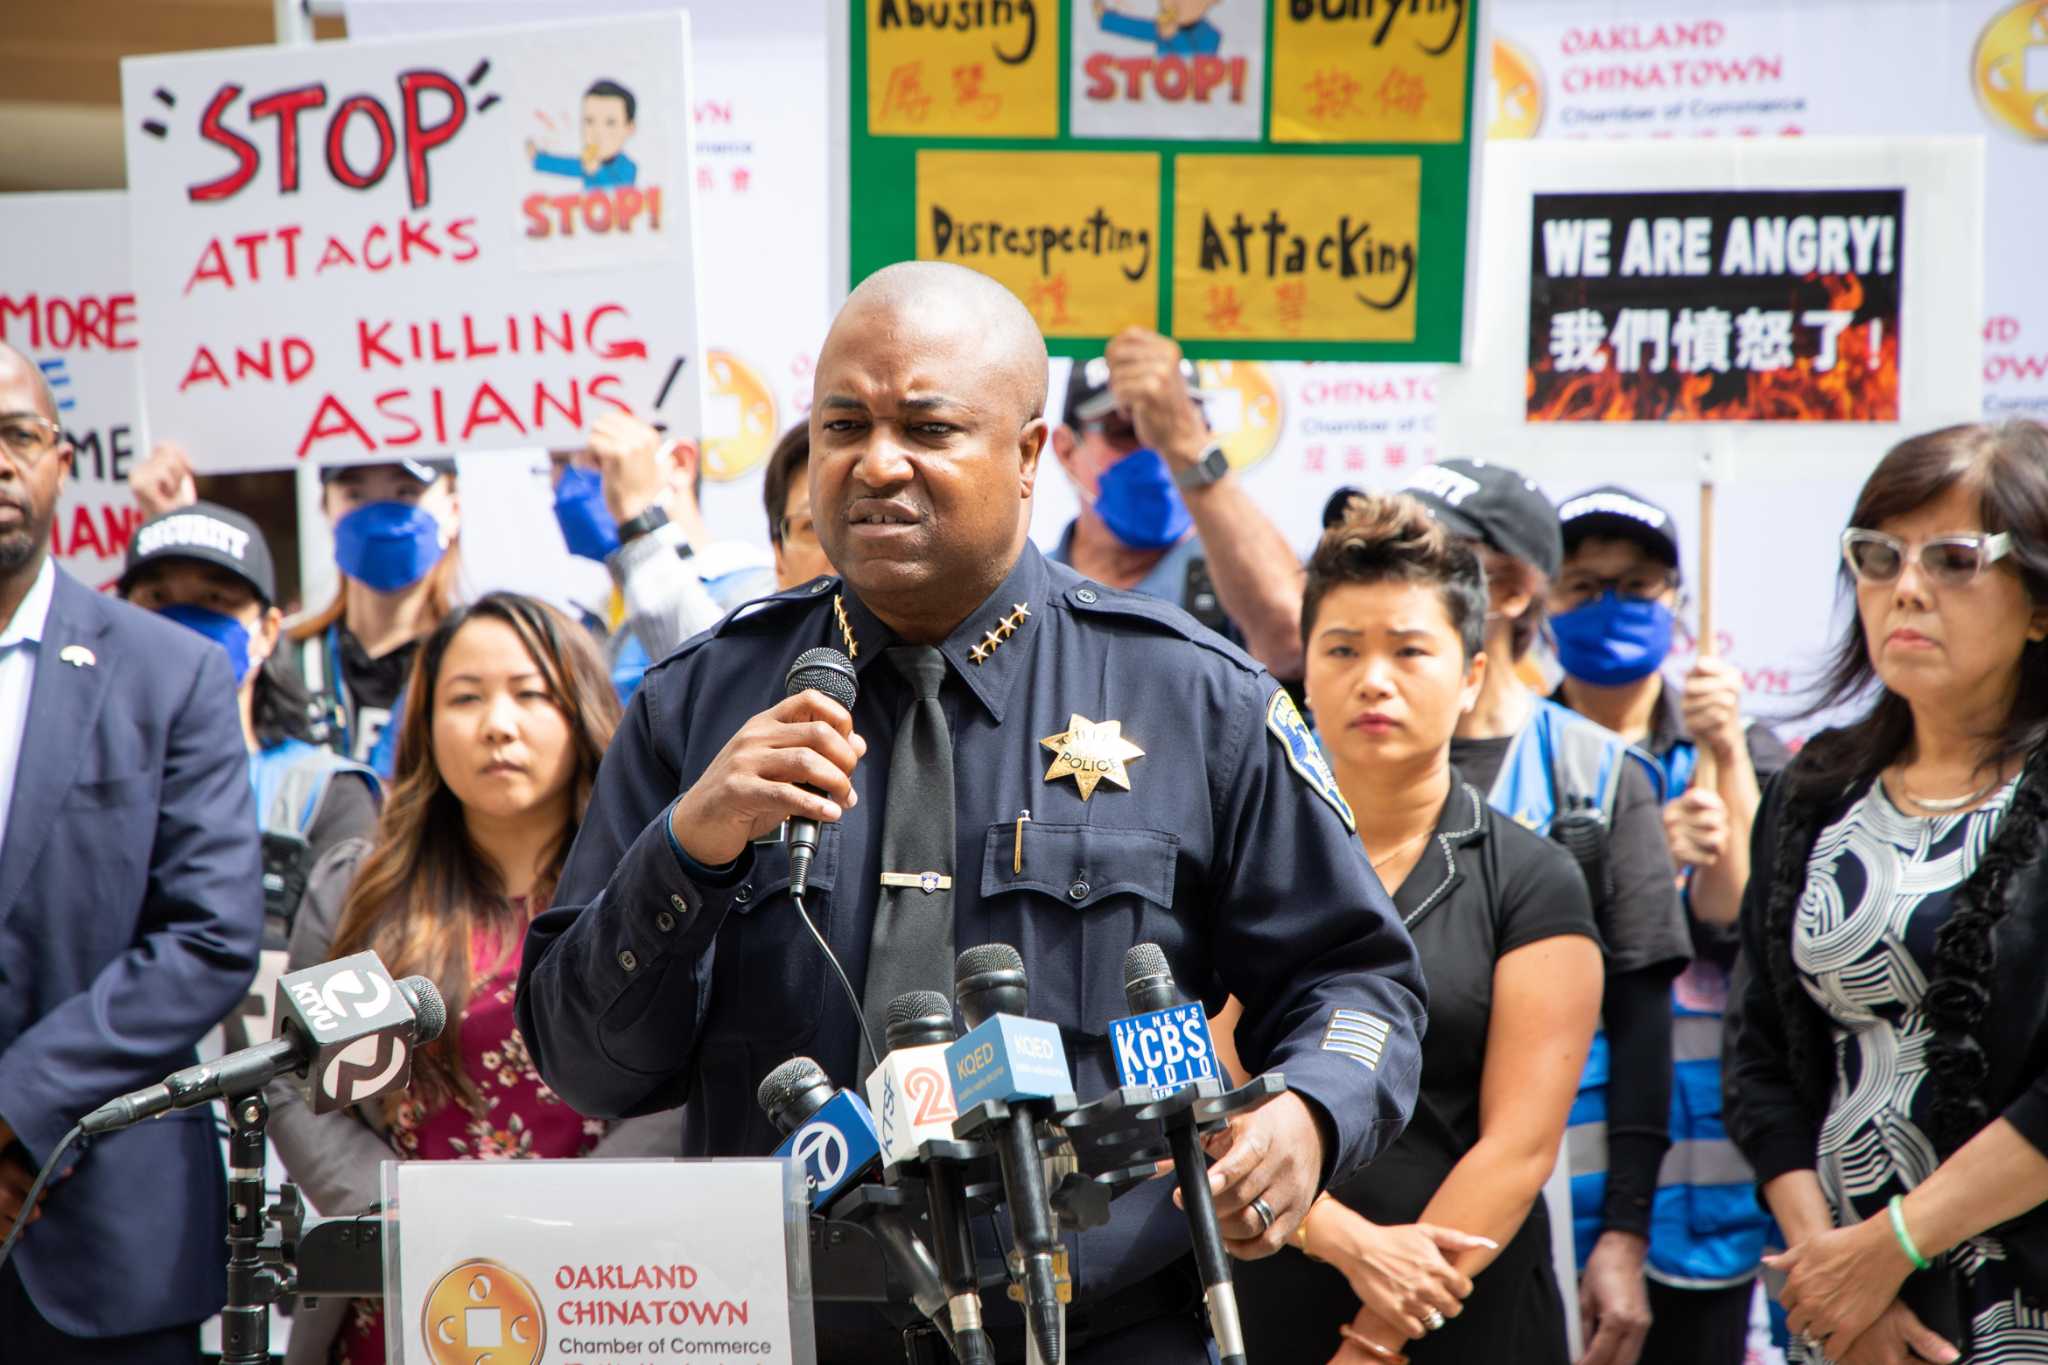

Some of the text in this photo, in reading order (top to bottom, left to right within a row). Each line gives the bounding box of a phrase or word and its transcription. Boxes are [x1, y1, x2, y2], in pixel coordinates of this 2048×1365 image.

[1560, 20, 1725, 55] OAKLAND
[1084, 52, 1247, 104] STOP!
[1560, 54, 1783, 93] CHINATOWN
[522, 186, 662, 239] STOP!
[184, 218, 479, 294] ATTACKS
[930, 204, 1150, 281] Disrespecting
[1543, 215, 1894, 277] WE ARE ANGRY!
[0, 292, 138, 353] MORE
[179, 304, 648, 392] AND KILLING
[290, 980, 339, 1031] KTVU
[1116, 1007, 1199, 1036] ALL NEWS
[956, 1042, 994, 1081] KQED
[1013, 1033, 1054, 1058] KQED
[1116, 1018, 1206, 1074] KCBS
[1125, 1056, 1212, 1088] RADIO
[881, 1069, 896, 1159] KTSF
[555, 1264, 697, 1290] OAKLAND
[557, 1299, 748, 1326] CHINATOWN
[559, 1337, 772, 1354] Chamber of Commerce
